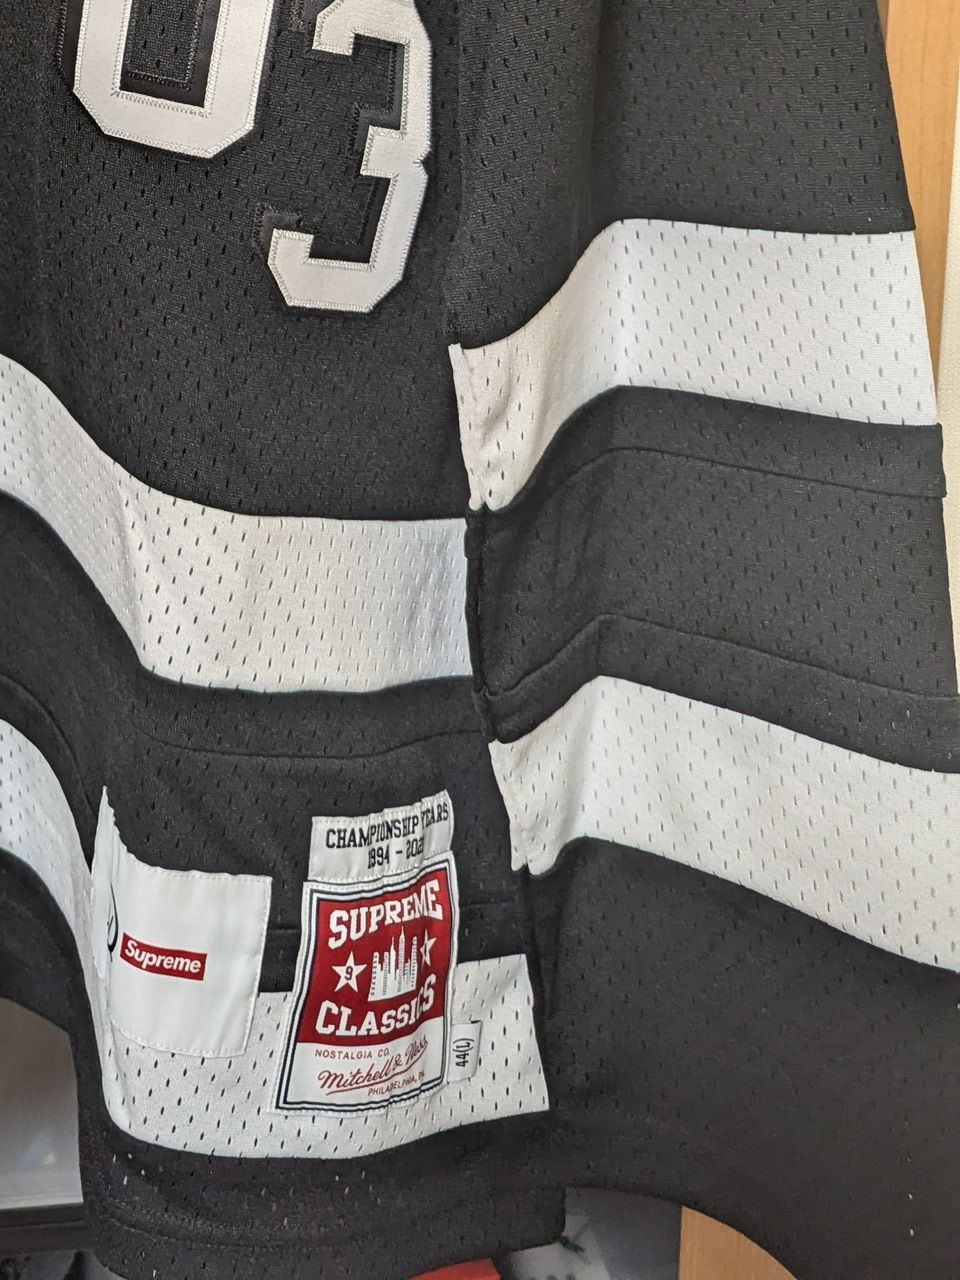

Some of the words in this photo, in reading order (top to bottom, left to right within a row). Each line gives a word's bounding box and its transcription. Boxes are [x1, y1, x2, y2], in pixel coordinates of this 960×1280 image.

[325, 814, 419, 849] CHAMPIONSHIP
[420, 802, 449, 830] YEARS
[367, 844, 390, 869] 1994
[328, 879, 444, 950] SUPREME
[124, 939, 202, 974] Supreme
[344, 965, 354, 981] 9
[315, 973, 437, 1037] CLASSICS
[315, 1048, 373, 1060] NOSTALGIA
[317, 1056, 394, 1089] Mitchell
[390, 1054, 403, 1071] &
[404, 1034, 428, 1066] Ness
[452, 1037, 475, 1068] 44(L)
